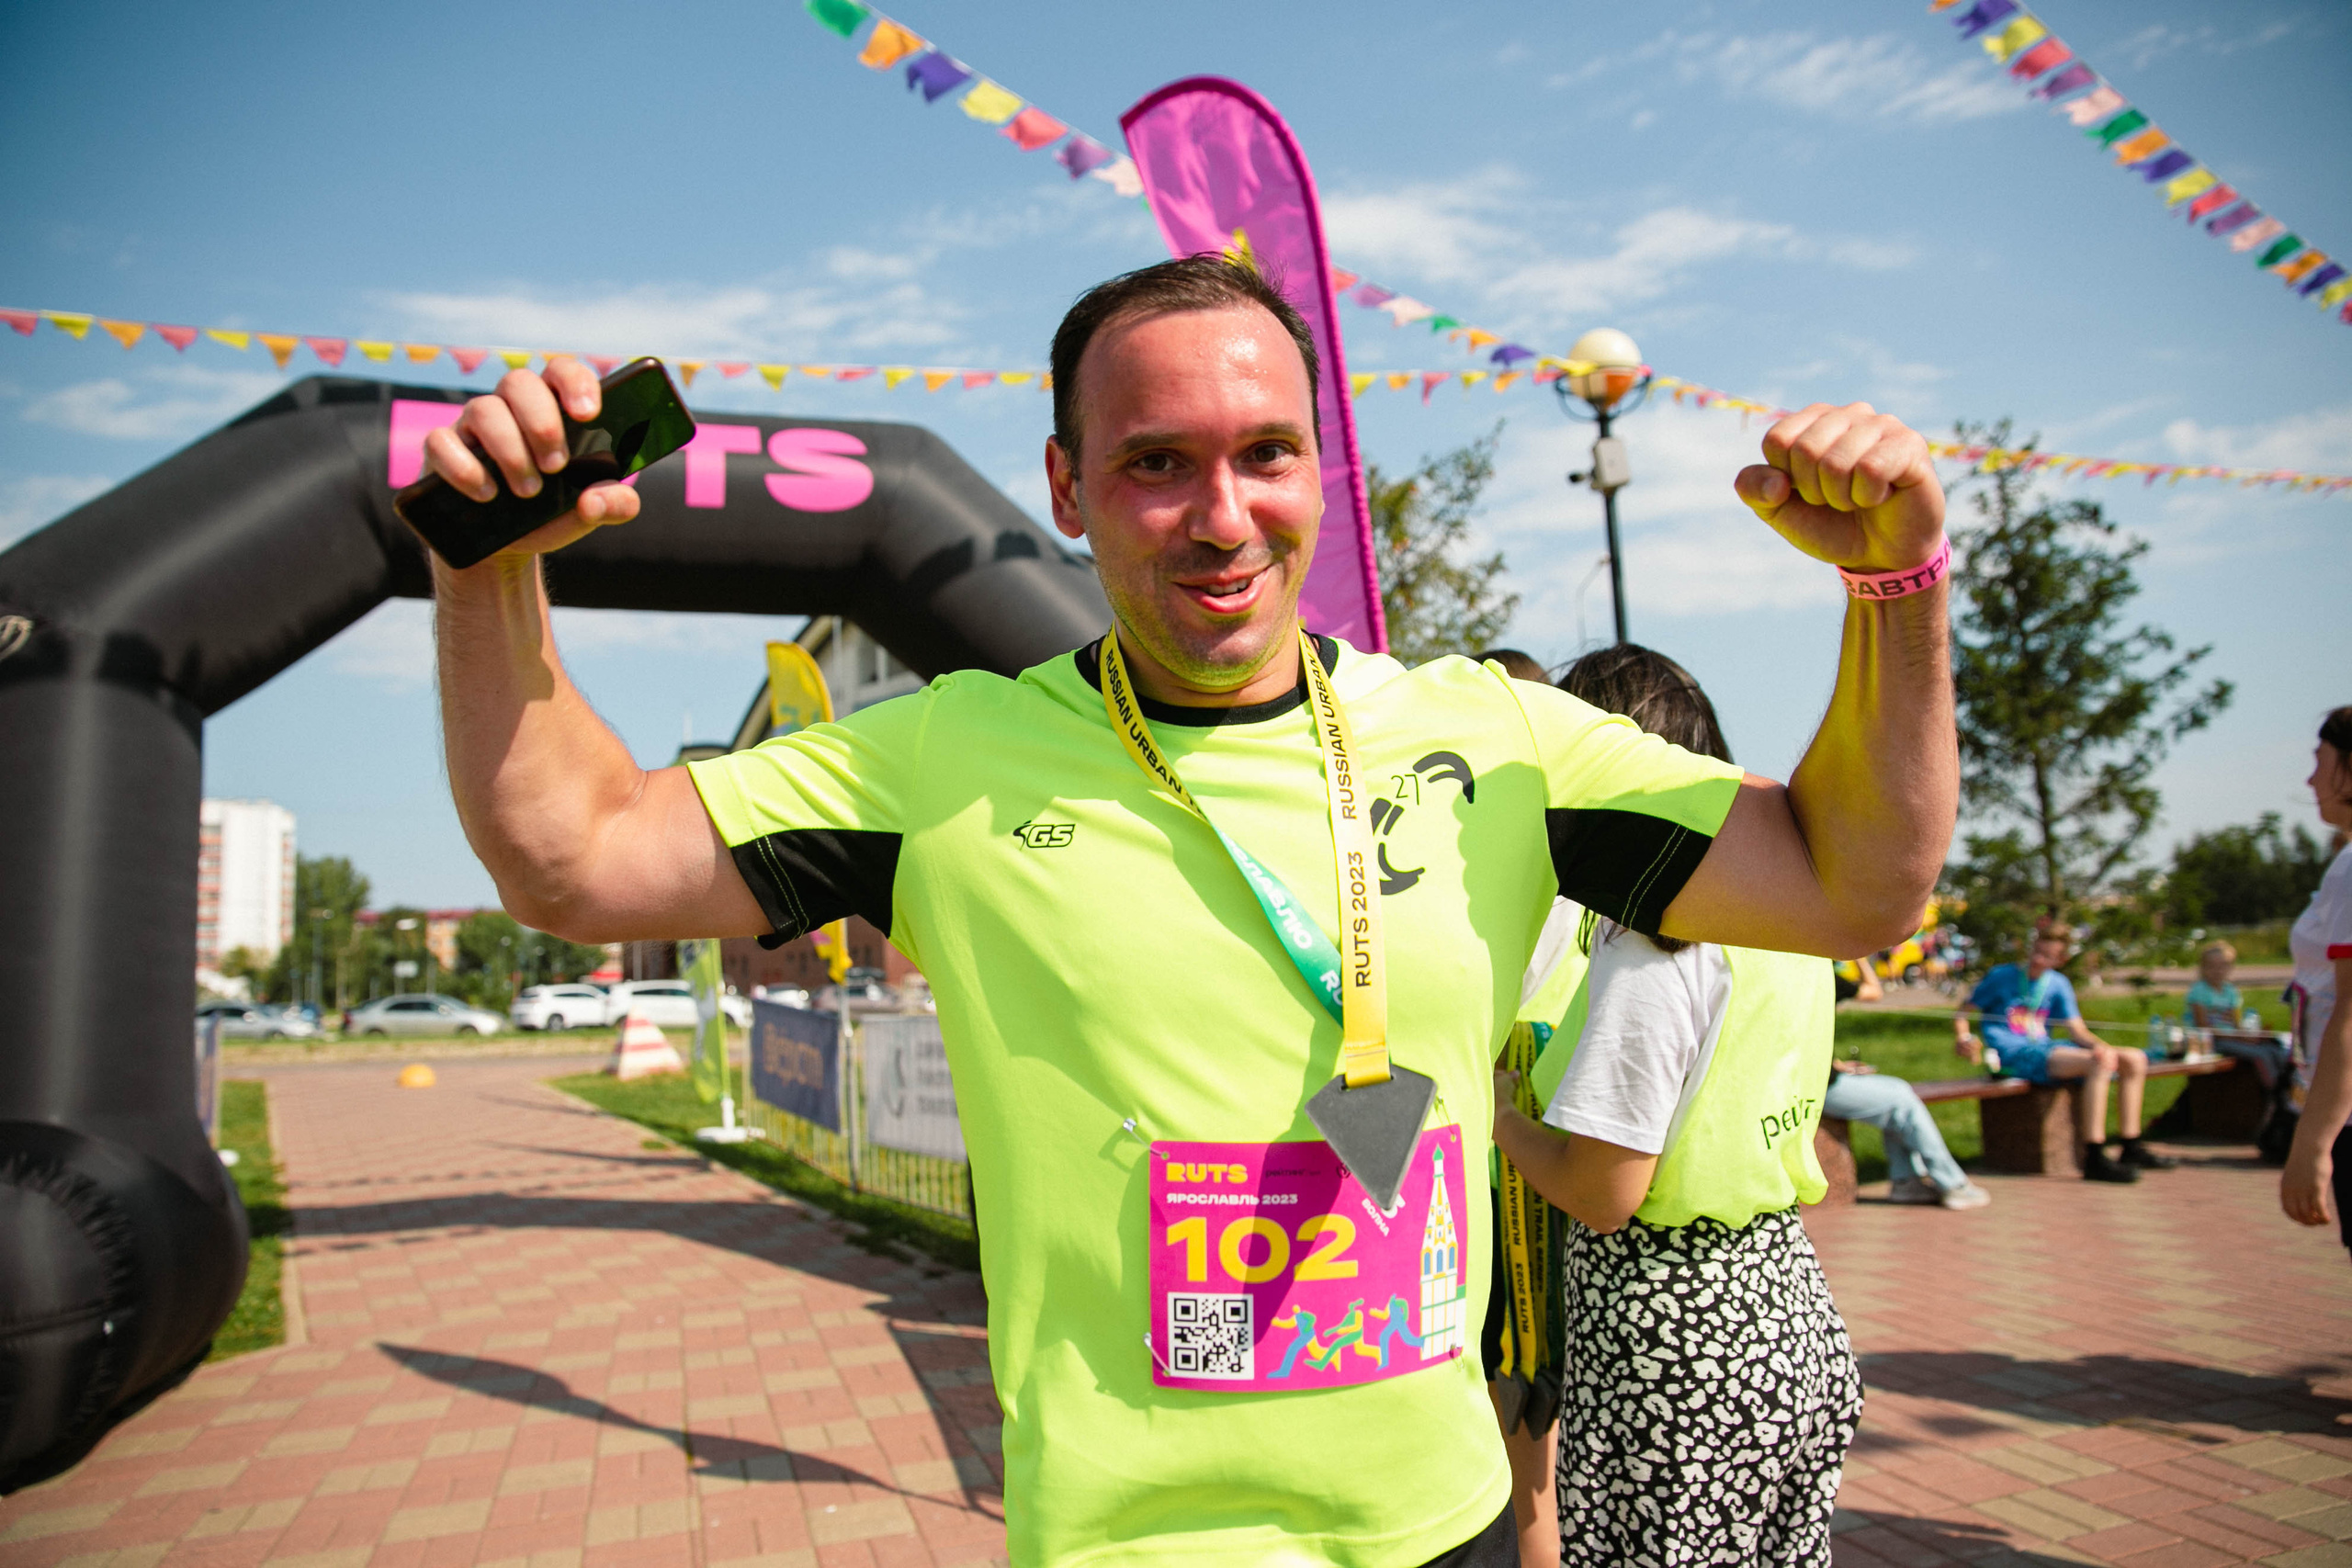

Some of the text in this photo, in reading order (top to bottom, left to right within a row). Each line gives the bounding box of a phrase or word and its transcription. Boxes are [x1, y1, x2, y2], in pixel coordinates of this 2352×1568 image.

[1105, 649, 1182, 794] RUSSIAN URBAN
[1307, 652, 1371, 987] RUTS 2023 RUSSIAN URBAN
[1167, 1162, 1249, 1184] RUTS
[1166, 1192, 1298, 1206] ЯРОСЛАВЛЬ 2023
[1362, 1197, 1390, 1237] ВОЛНА
[1510, 1186, 1521, 1246] RUSSIAN
[1166, 1213, 1359, 1284] 102
[1515, 1262, 1525, 1294] 2023
[1520, 1298, 1530, 1334] RUTS
